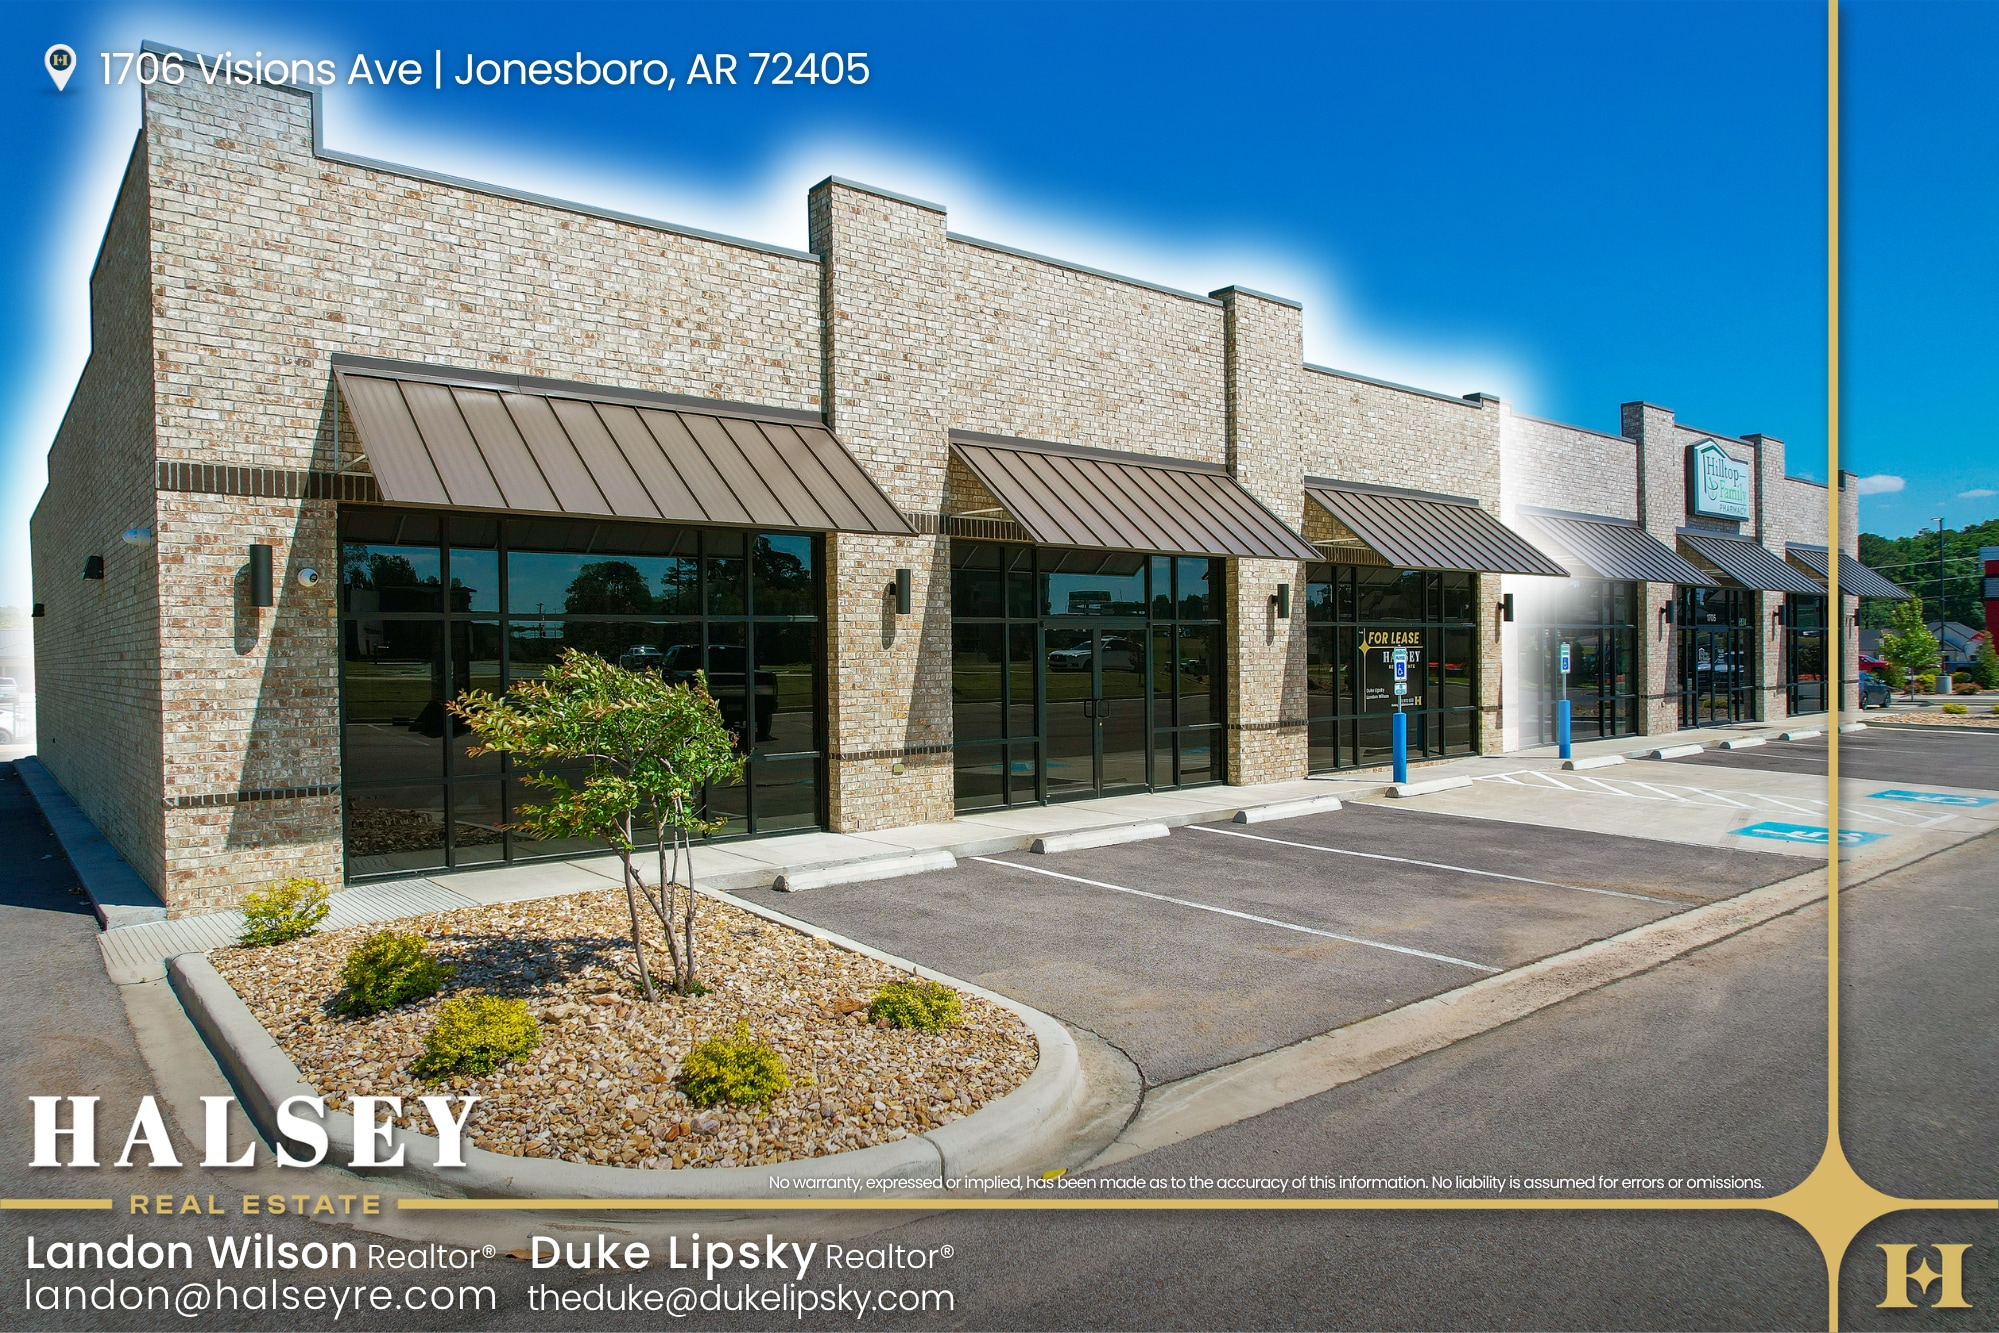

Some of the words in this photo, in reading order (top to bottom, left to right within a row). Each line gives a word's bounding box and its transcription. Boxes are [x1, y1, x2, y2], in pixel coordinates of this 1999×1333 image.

[1706, 456, 1739, 487] Hilltop
[1720, 480, 1747, 504] Family
[1368, 632, 1388, 644] FOR
[1391, 632, 1420, 644] LEASE
[1383, 651, 1421, 663] HSEY
